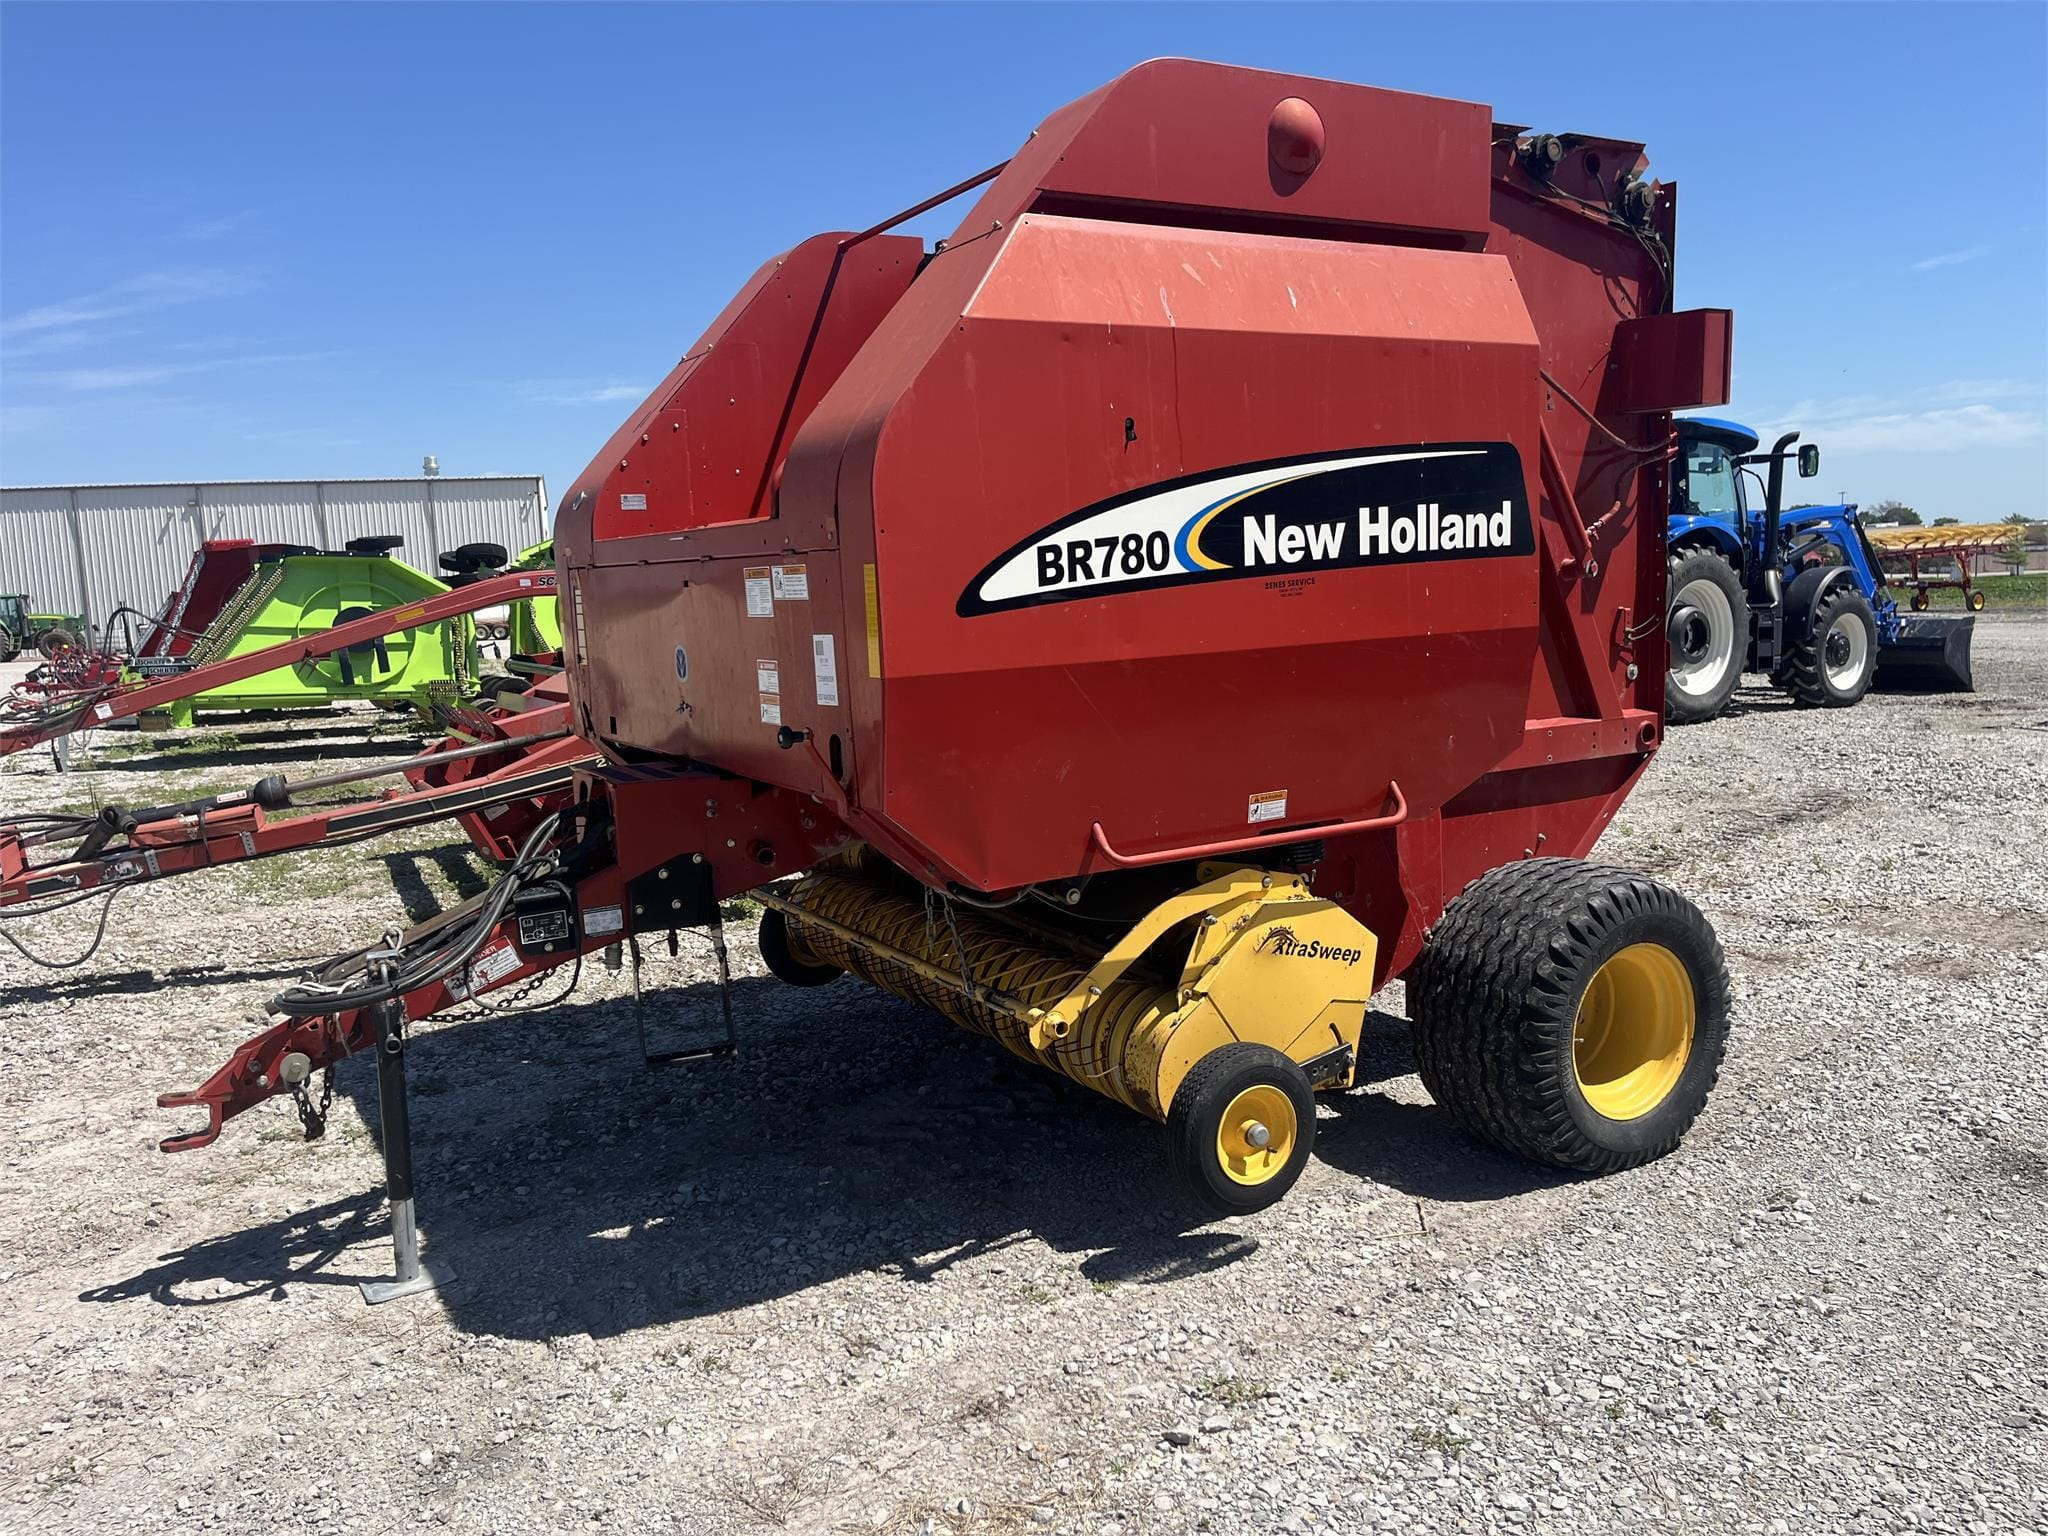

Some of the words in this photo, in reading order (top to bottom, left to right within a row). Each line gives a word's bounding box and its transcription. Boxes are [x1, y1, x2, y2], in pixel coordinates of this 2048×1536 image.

[1243, 514, 1346, 567] New
[1358, 500, 1512, 555] Holland
[1037, 531, 1170, 587] BR780
[538, 576, 558, 586] SC
[1287, 577, 1316, 587] SERVICE
